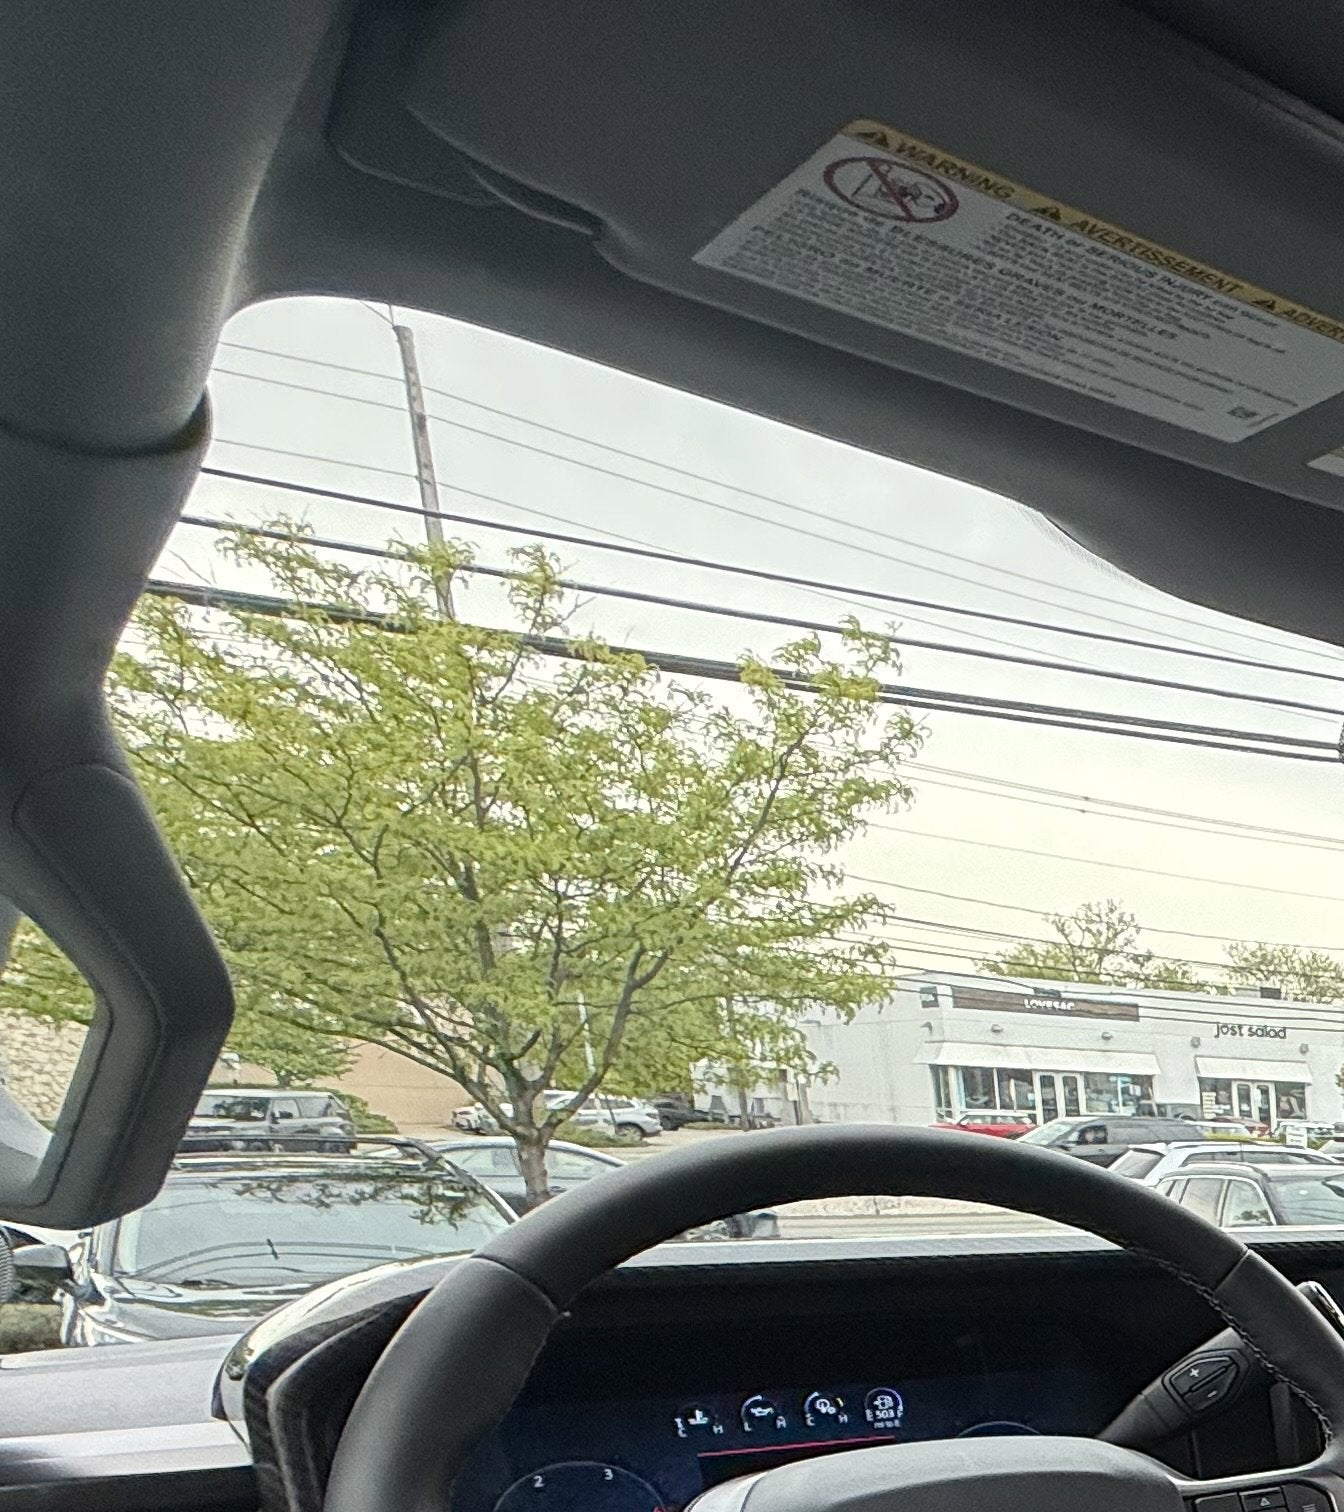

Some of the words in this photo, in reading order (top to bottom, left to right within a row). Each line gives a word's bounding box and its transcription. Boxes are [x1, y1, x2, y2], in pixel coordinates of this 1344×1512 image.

[892, 142, 1019, 200] WARNING
[1067, 217, 1243, 294] AVERTISSEMENT
[887, 224, 999, 270] BLESSURES
[996, 266, 1069, 296] GRAVES
[1004, 212, 1067, 240] DEATH
[1084, 246, 1159, 278] SERIOUS
[1155, 275, 1214, 301] INJURY
[1248, 1024, 1287, 1039] salad
[875, 1409, 894, 1418] 503
[533, 1475, 545, 1488] 2
[604, 1468, 614, 1480] 3
